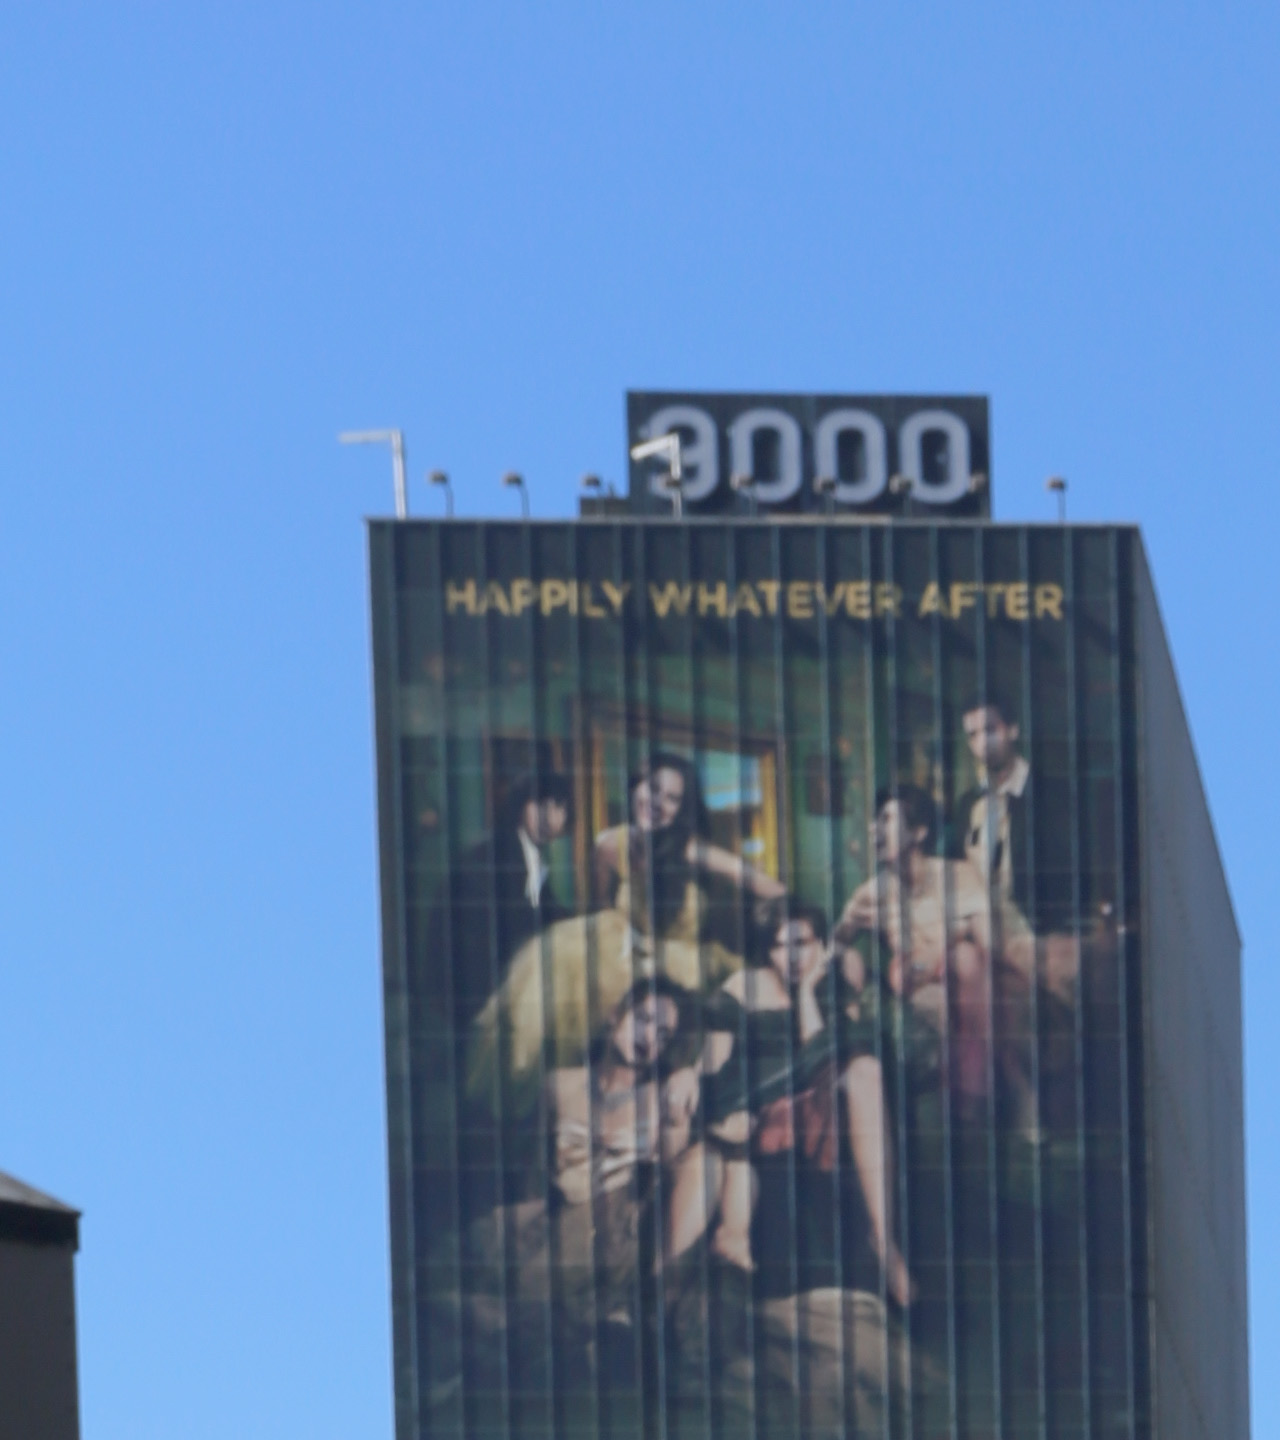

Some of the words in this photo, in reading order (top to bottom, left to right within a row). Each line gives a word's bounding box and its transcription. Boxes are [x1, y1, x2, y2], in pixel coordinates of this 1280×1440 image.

[642, 405, 971, 504] 9000
[446, 578, 631, 618] HAPPILY
[651, 578, 902, 619] WHATEVER
[918, 580, 1064, 620] AFTER
